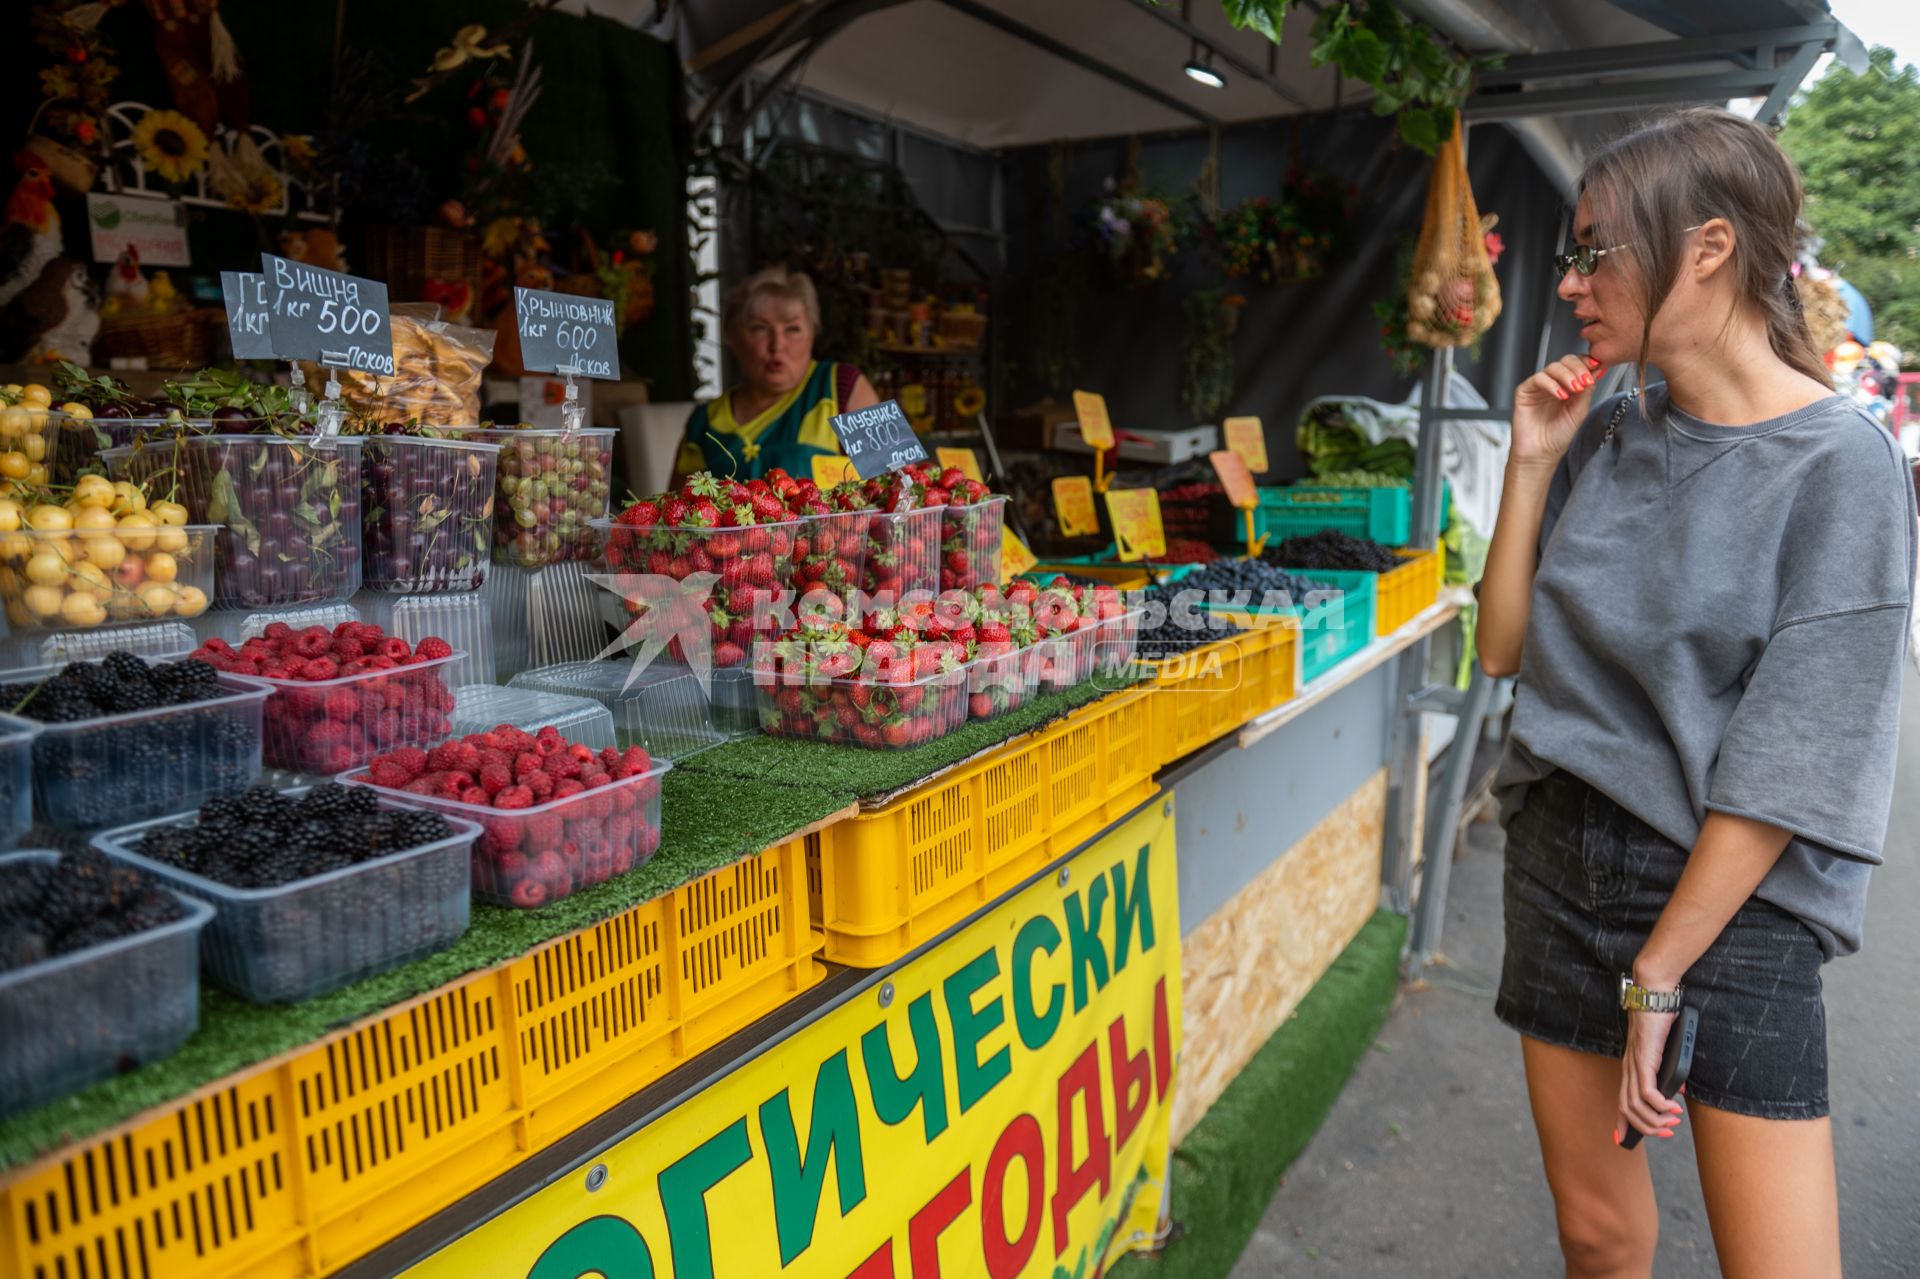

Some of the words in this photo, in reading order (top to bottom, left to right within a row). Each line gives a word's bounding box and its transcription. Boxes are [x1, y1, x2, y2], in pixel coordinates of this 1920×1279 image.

[317, 300, 381, 335] 500
[556, 320, 597, 351] 600
[864, 421, 901, 452] 800
[845, 974, 1172, 1279] ГОДЫ
